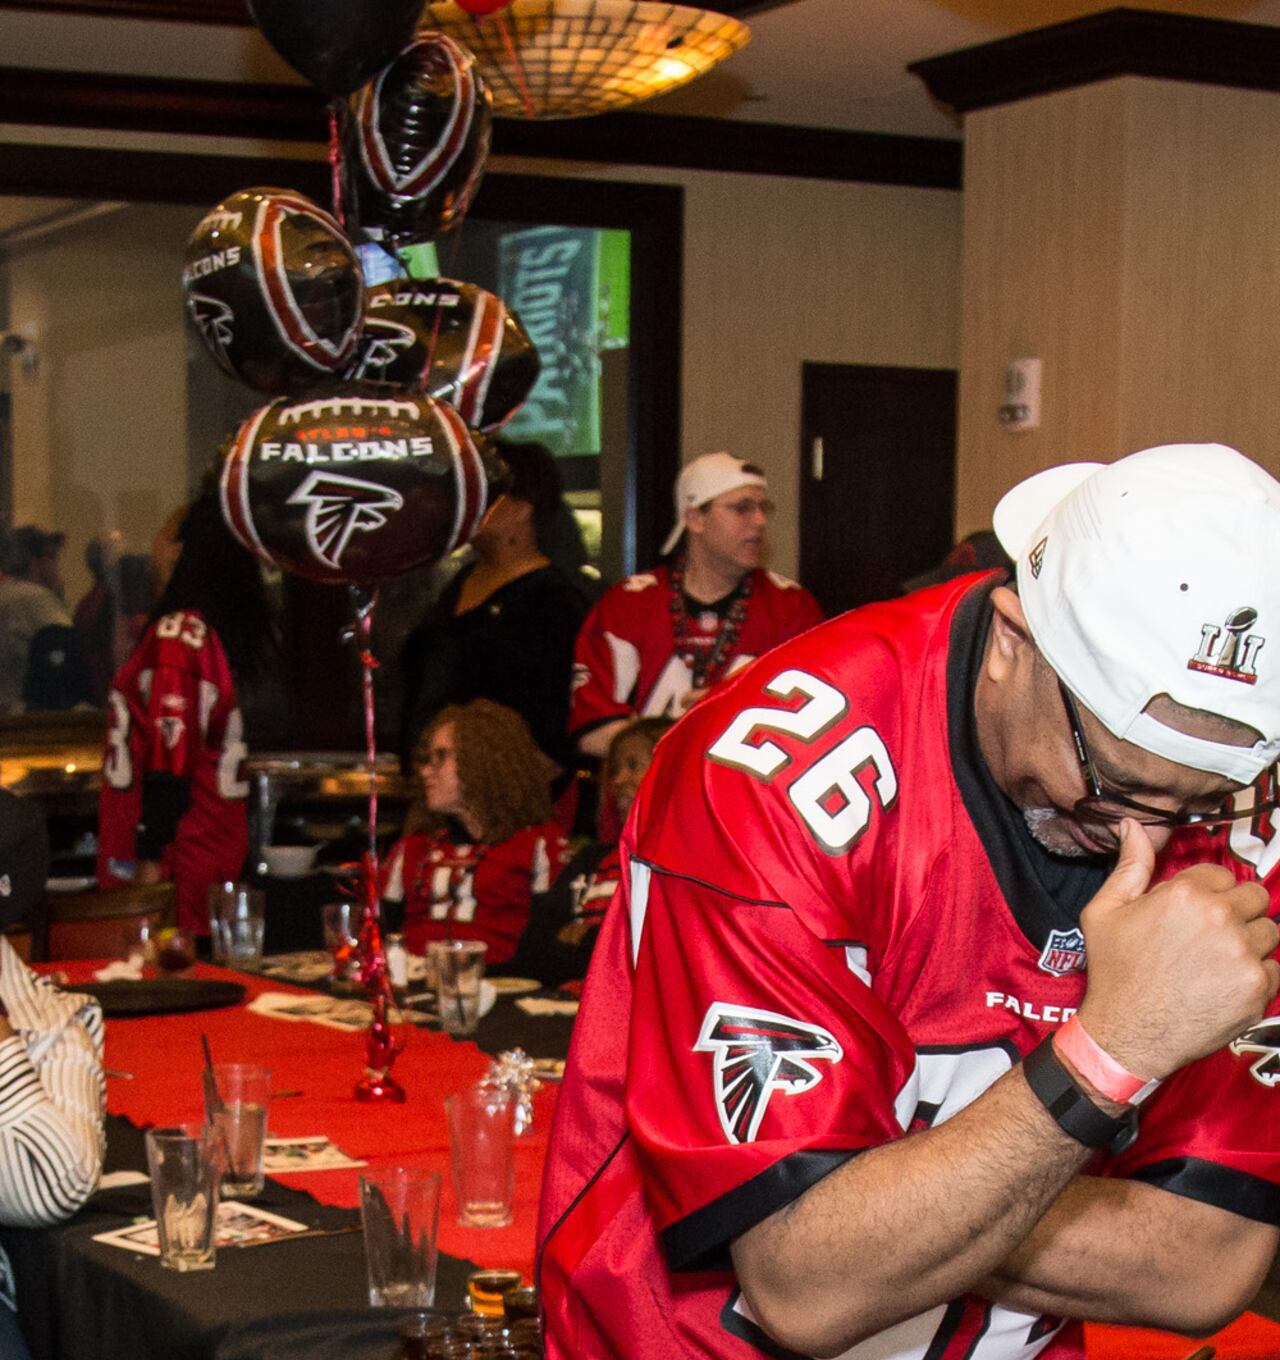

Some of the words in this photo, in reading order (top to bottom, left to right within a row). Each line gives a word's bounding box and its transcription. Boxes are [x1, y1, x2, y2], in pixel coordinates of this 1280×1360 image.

[370, 292, 460, 308] CONS
[260, 436, 434, 463] FALCONS
[706, 668, 900, 856] 26
[985, 991, 1078, 1023] FALC
